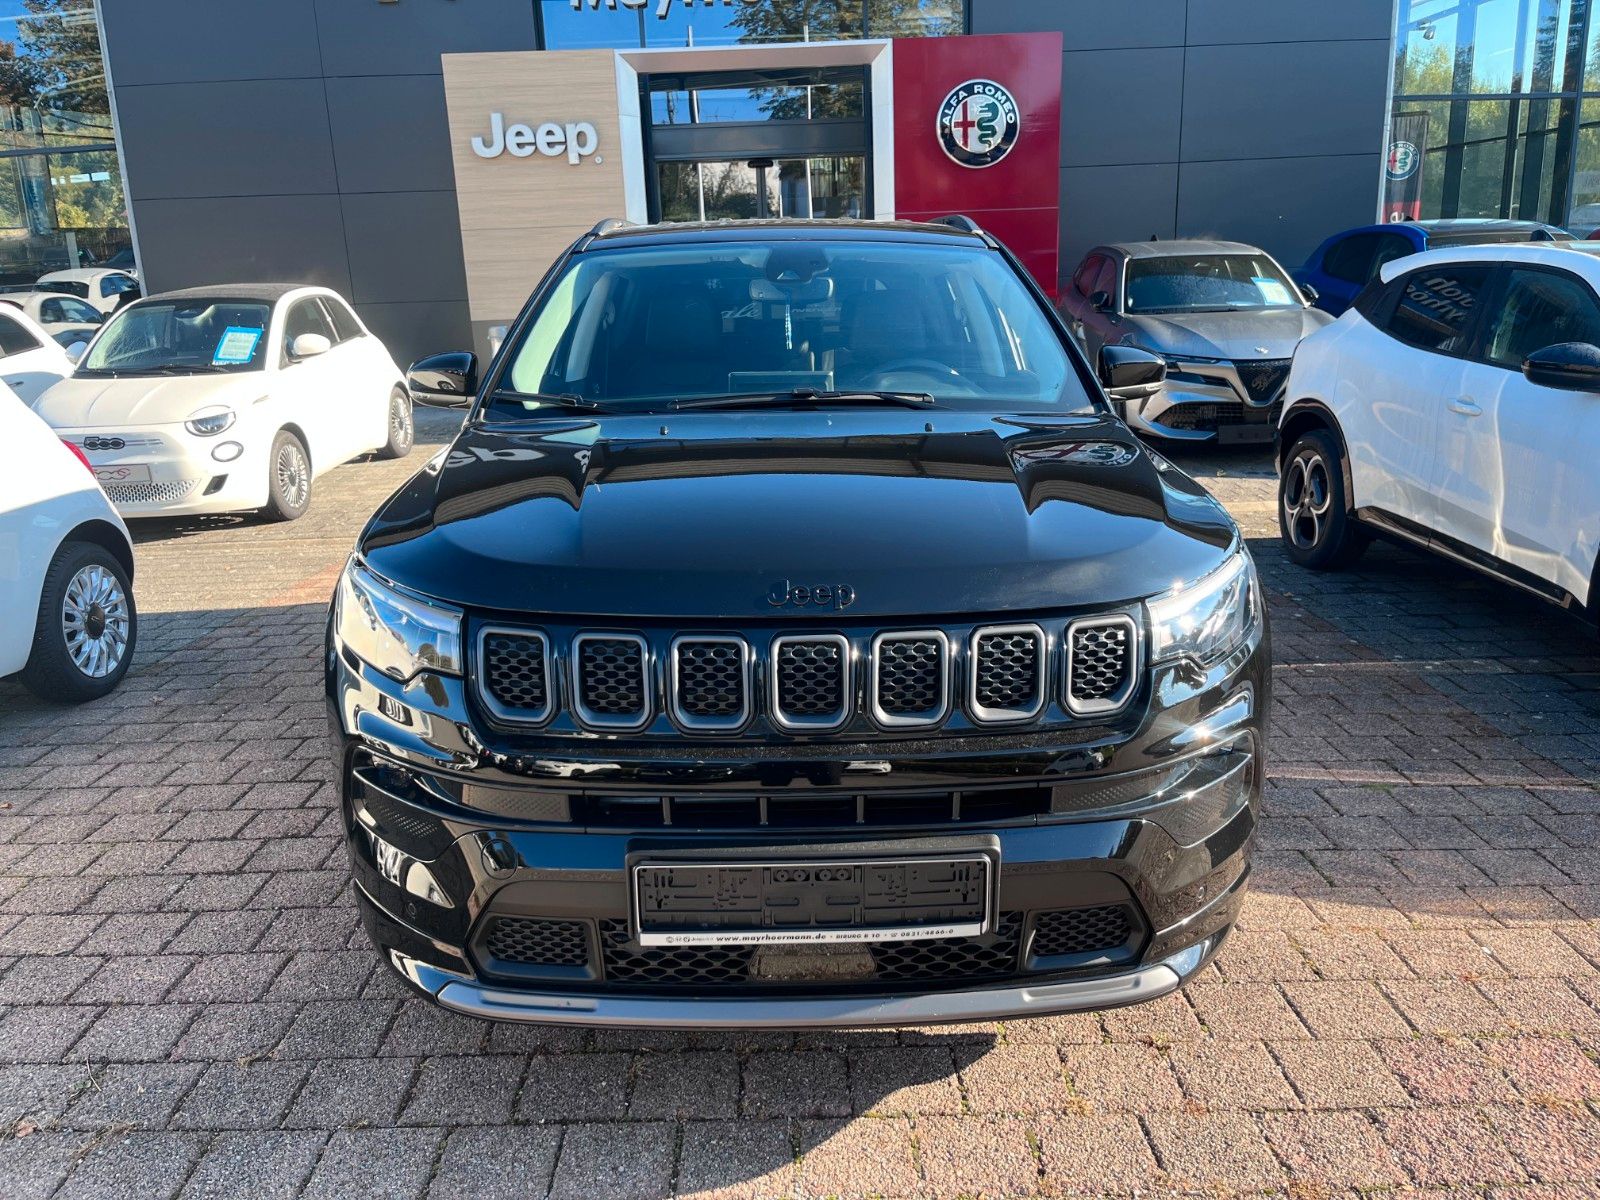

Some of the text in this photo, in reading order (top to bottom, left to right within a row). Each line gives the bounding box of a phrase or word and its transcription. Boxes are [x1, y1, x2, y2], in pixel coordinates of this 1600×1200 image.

[943, 84, 1015, 126] ALFA ROMEO
[471, 112, 598, 165] Jeep
[84, 436, 125, 450] 500
[767, 579, 855, 609] Jeep
[716, 933, 826, 942] www.mayrhoermann.de
